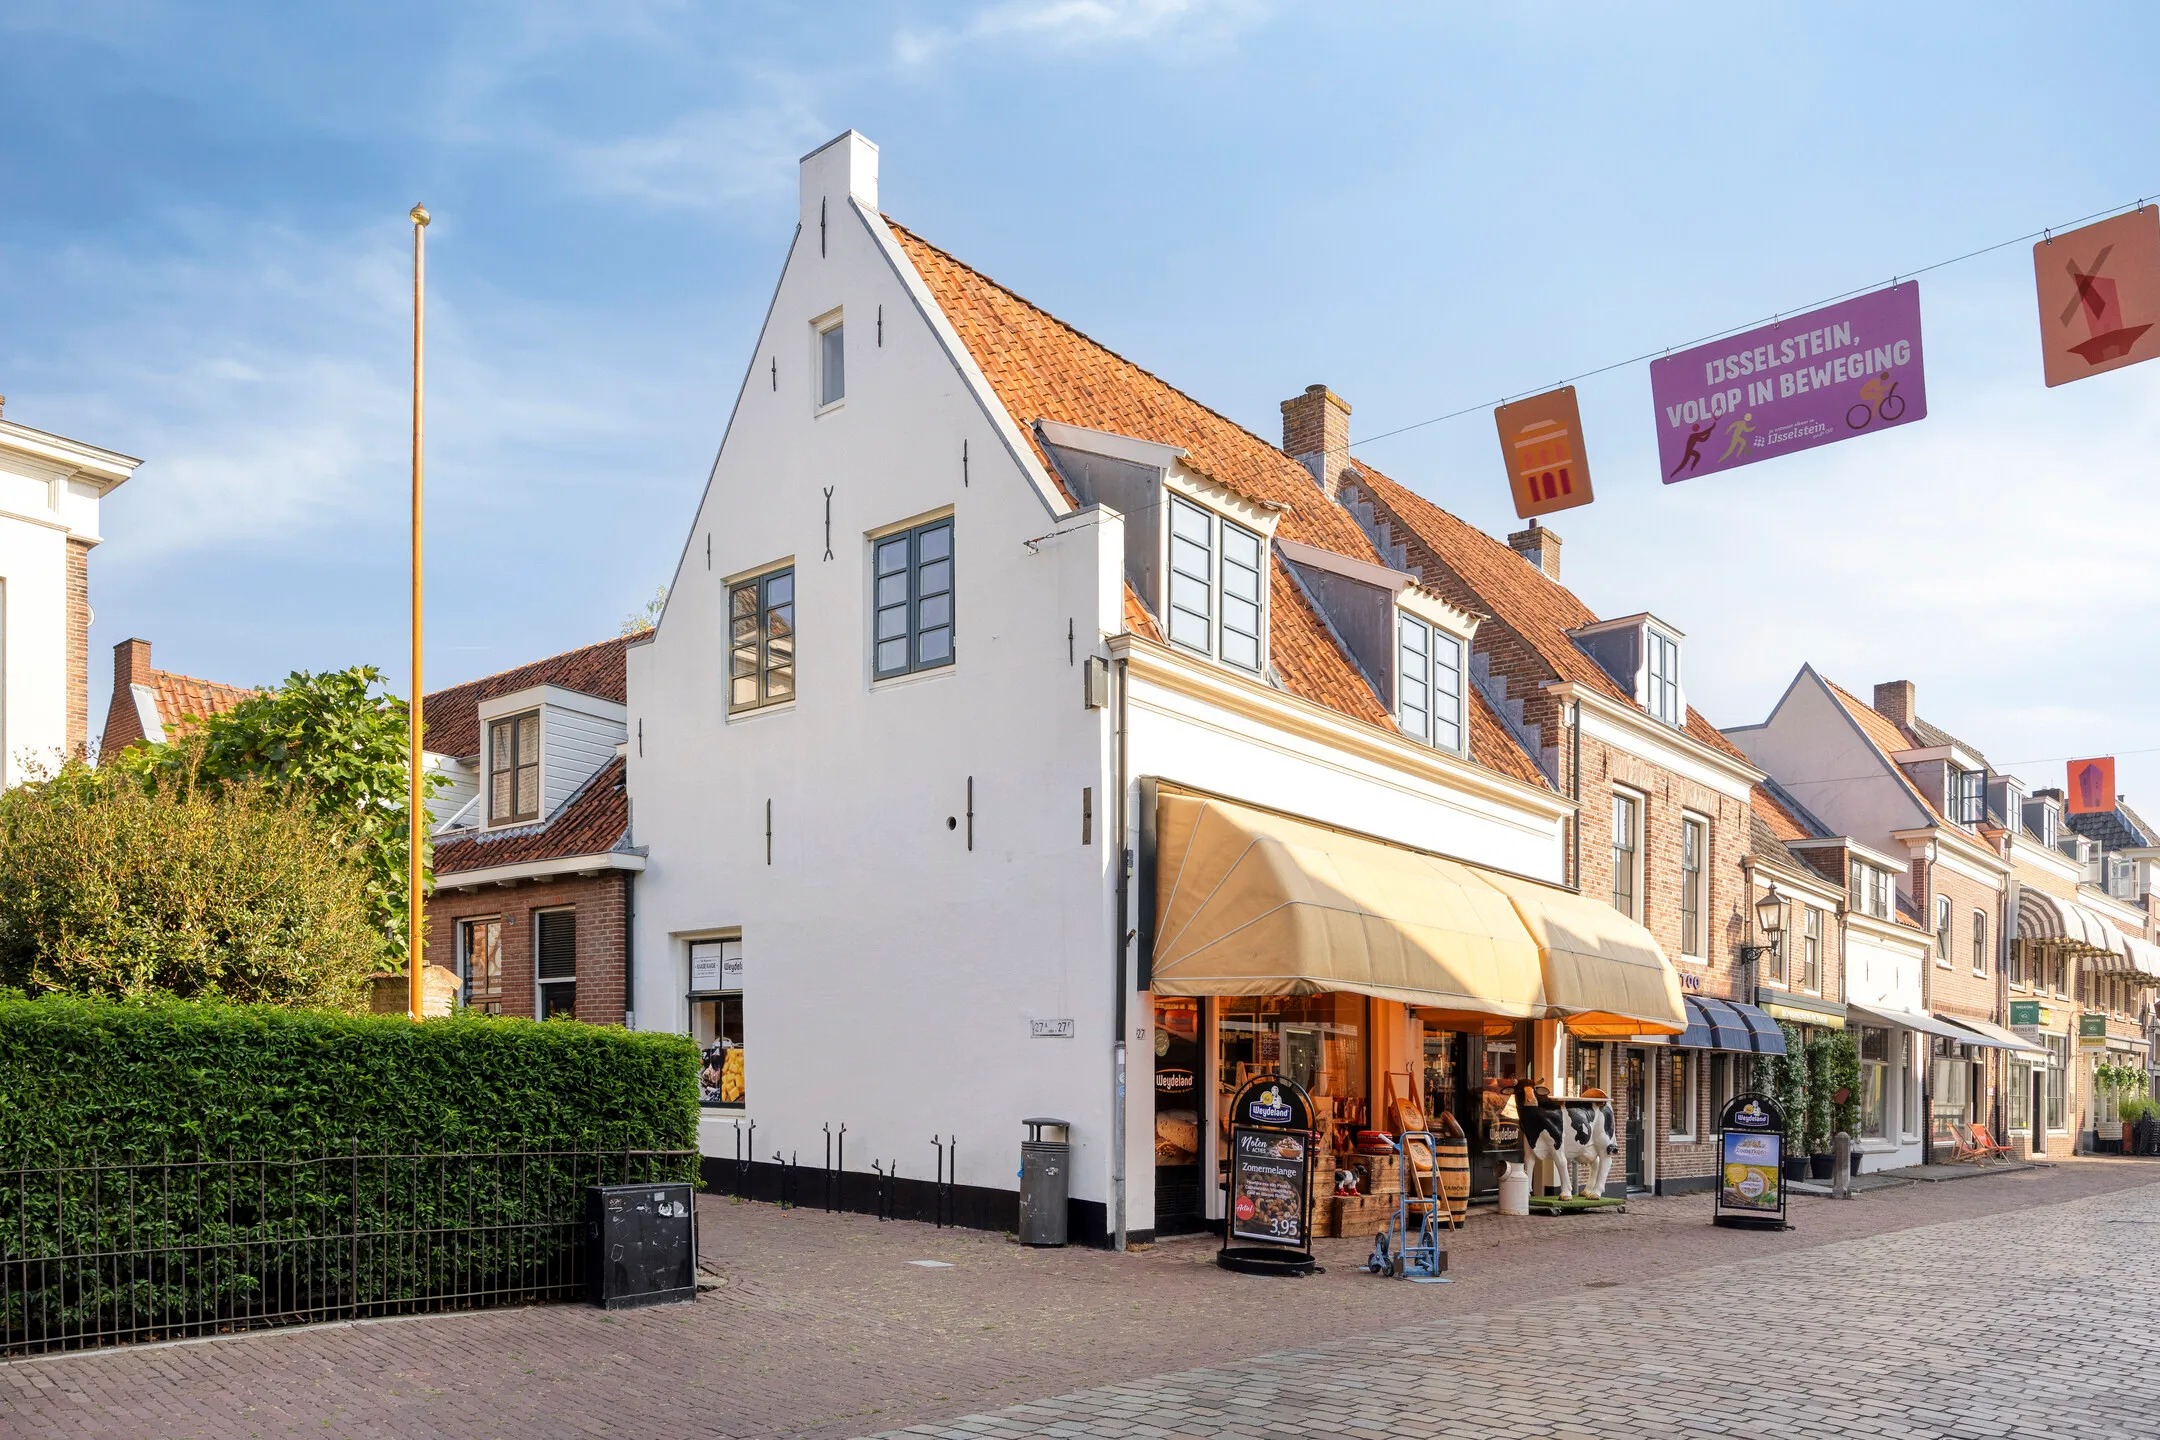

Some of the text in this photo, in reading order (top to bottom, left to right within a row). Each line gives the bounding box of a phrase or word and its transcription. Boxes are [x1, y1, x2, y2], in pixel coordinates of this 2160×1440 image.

[1705, 321, 1860, 386] IJSSELSTEIN,
[1666, 339, 1911, 428] VOLOP IN BEWEGING
[1767, 422, 1826, 445] IJsselstein
[1136, 1028, 1145, 1039] 27
[1156, 1073, 1193, 1089] Weydeland
[1252, 1105, 1289, 1117] Weydeland
[1241, 1135, 1268, 1152] Noten
[1489, 1127, 1519, 1144] Weydeland
[1242, 1162, 1297, 1178] Zomermelange
[1270, 1217, 1298, 1236] 3,95
